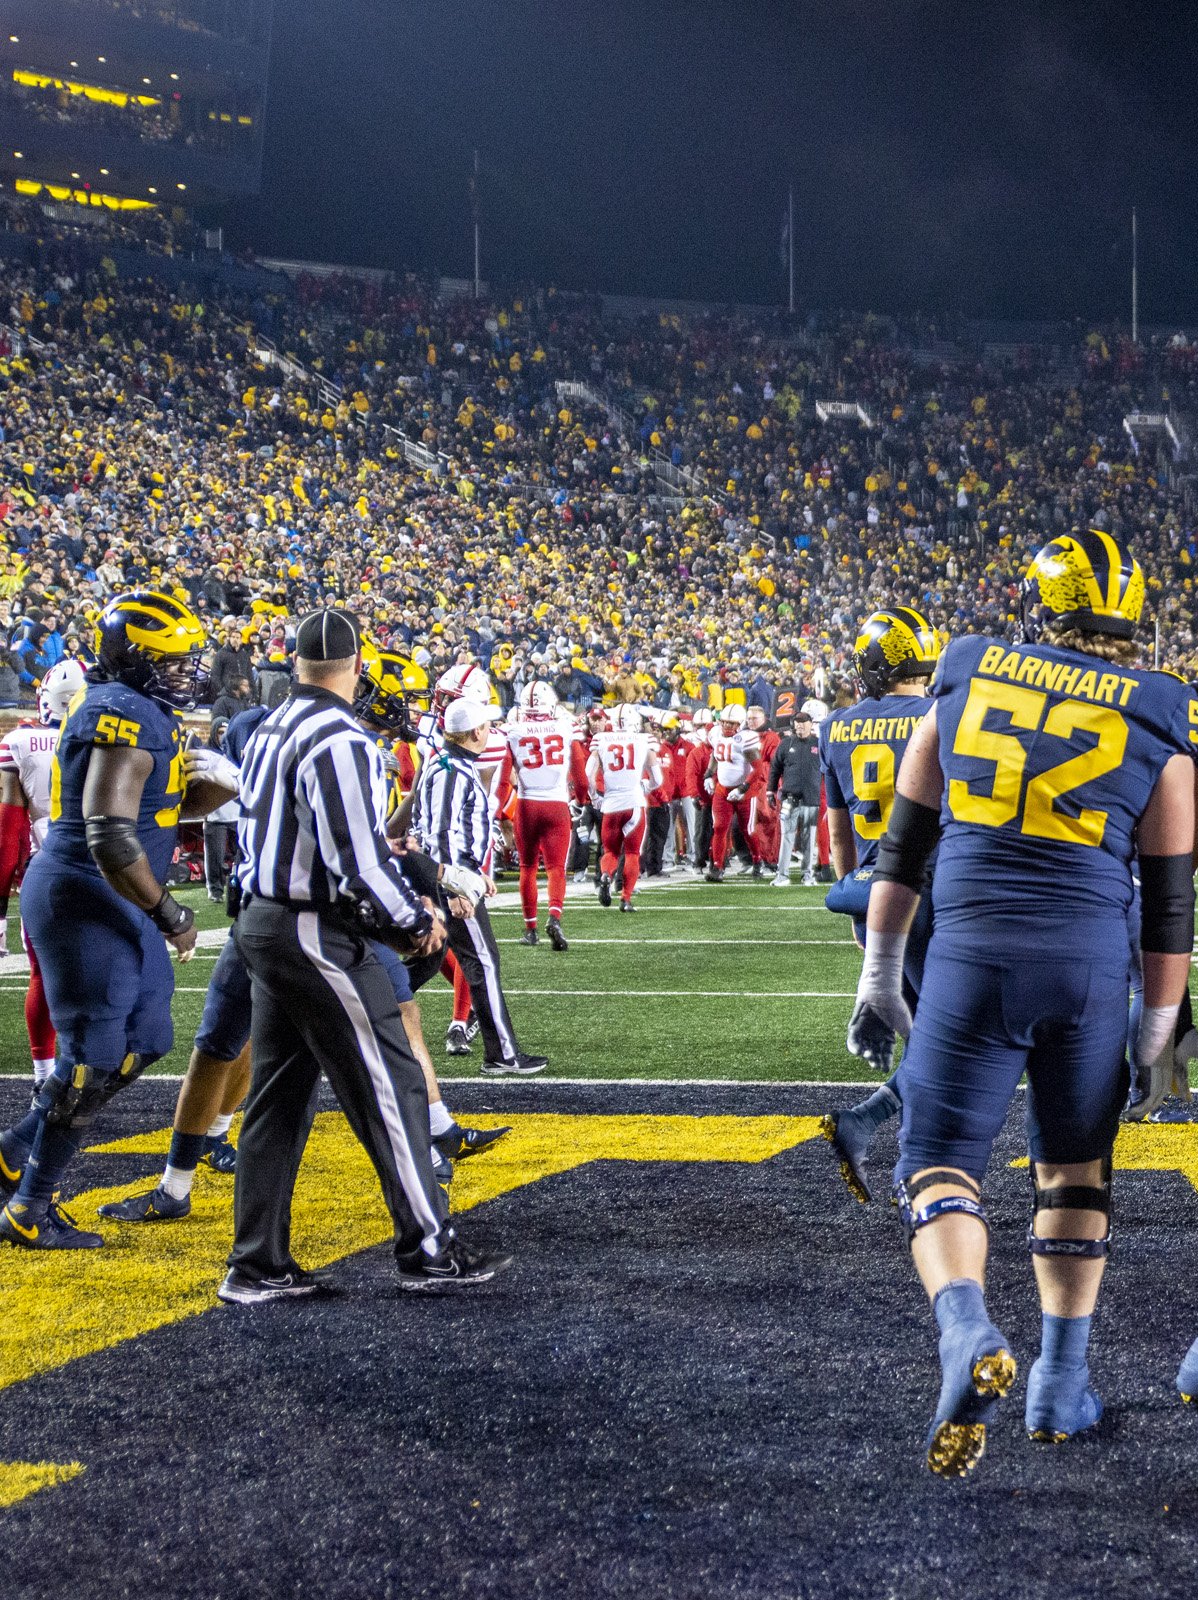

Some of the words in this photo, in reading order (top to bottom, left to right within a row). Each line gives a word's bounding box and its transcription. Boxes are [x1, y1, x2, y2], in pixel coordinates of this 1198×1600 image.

[978, 646, 1139, 707] BARNHART
[776, 691, 795, 717] 2
[94, 714, 141, 747] 55
[519, 734, 564, 769] 32
[607, 743, 635, 771] 31
[948, 677, 1130, 847] 52
[850, 743, 895, 840] 9
